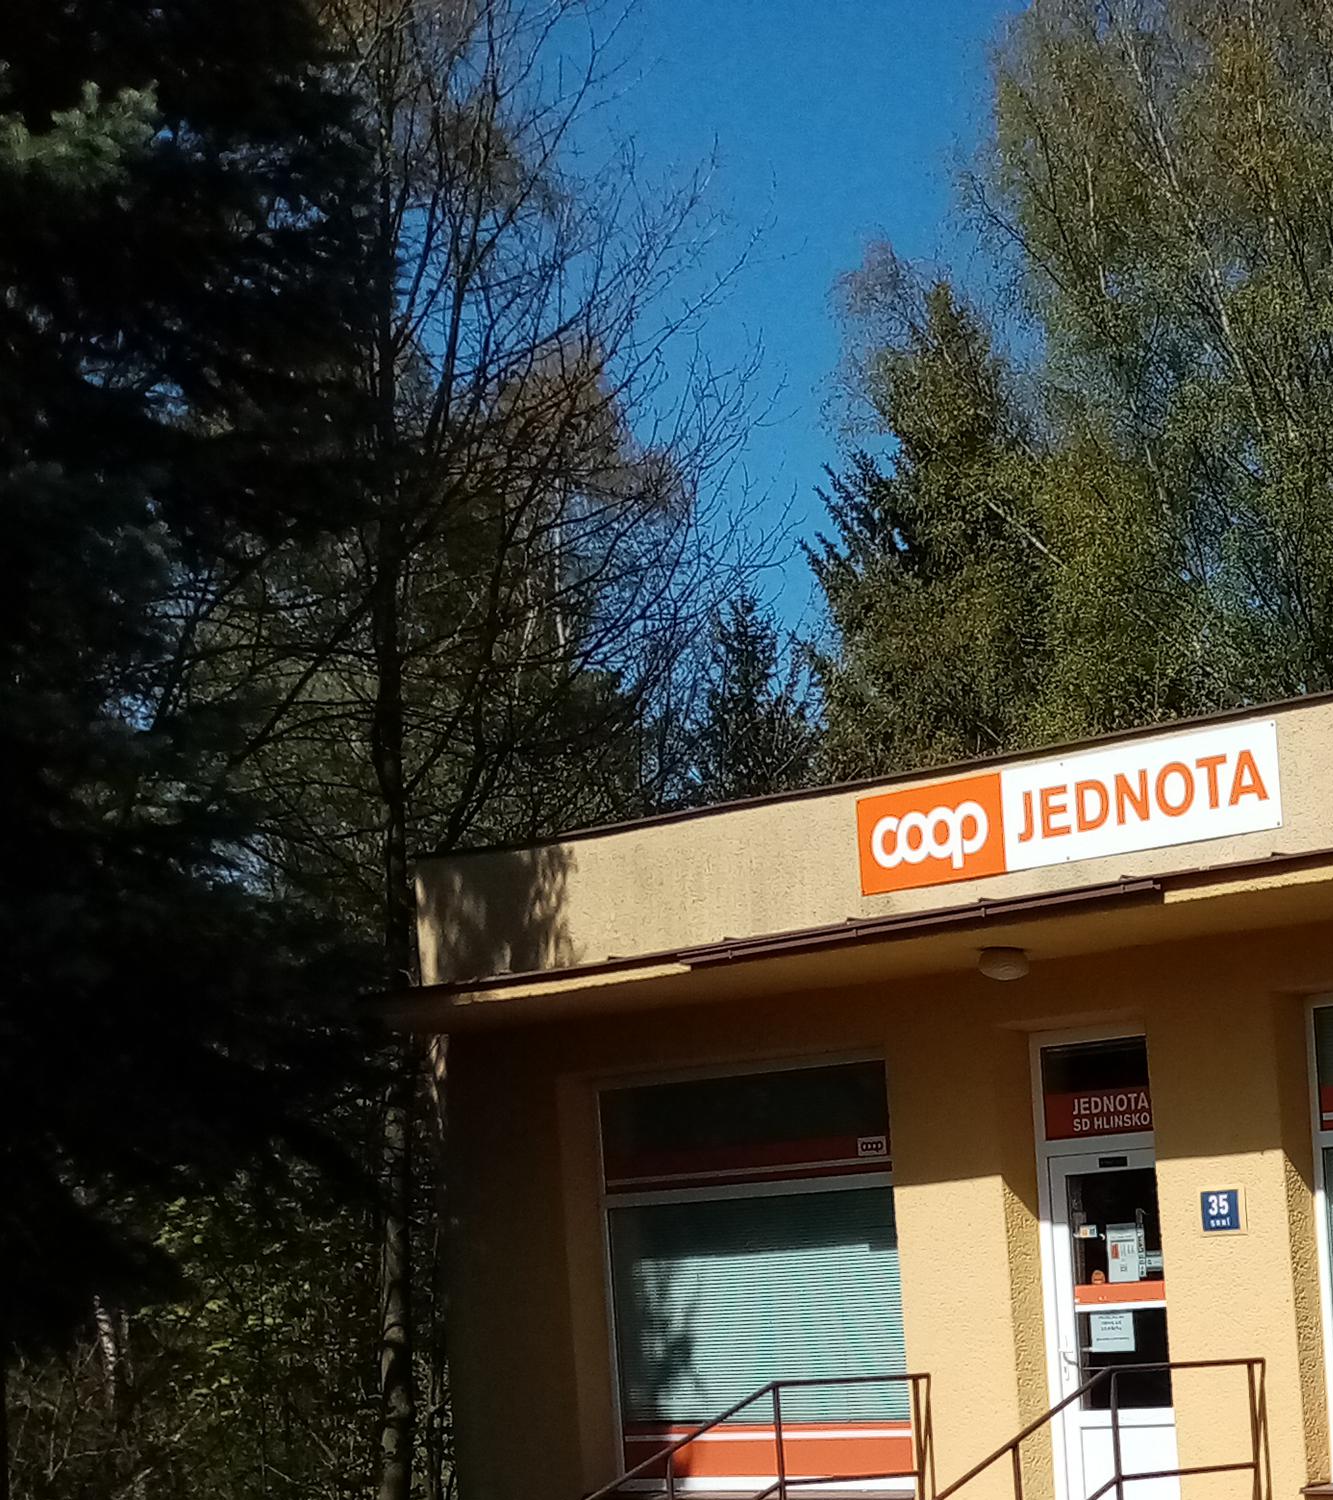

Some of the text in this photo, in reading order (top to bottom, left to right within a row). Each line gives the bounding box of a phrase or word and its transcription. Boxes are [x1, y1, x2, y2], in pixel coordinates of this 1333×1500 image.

[870, 749, 1270, 870] coop JEDNOTA
[1072, 1092, 1150, 1115] JEDNOTA
[1073, 1112, 1150, 1132] SD HLINSKO
[1208, 1194, 1229, 1216] 35
